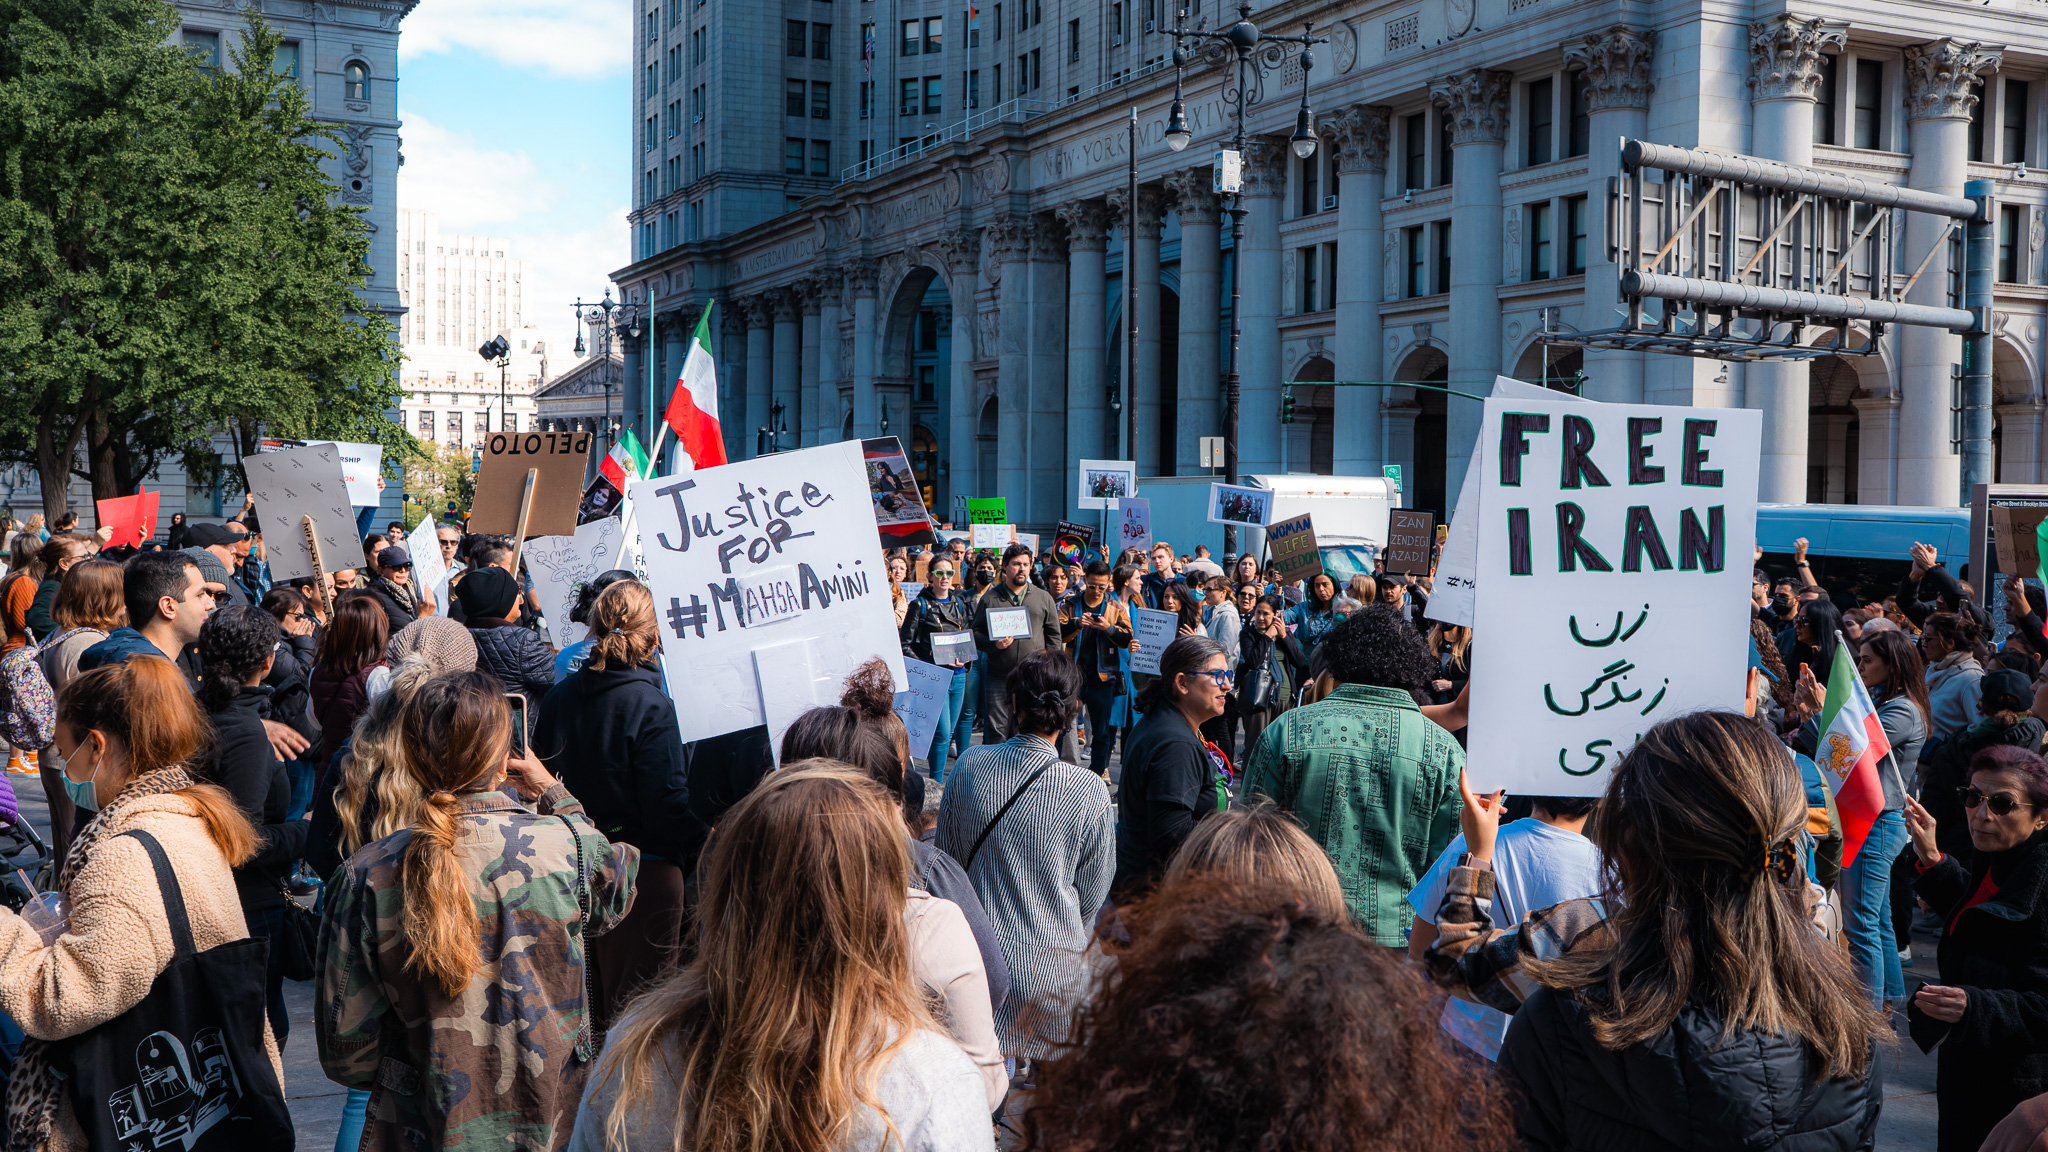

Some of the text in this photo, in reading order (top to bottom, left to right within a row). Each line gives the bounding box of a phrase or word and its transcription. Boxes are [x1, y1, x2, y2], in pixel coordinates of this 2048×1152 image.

[1043, 100, 1226, 177] NEW YORK MDXIV
[744, 246, 789, 276] AMSTERDAM
[483, 432, 589, 455] PELOTO
[1500, 412, 1724, 489] FREE
[655, 479, 833, 552] Justice
[969, 509, 1004, 517] WOMEN
[1397, 516, 1424, 529] ZAN
[1267, 517, 1311, 541] WOMAN
[1391, 534, 1429, 548] ZENDEGI
[1507, 502, 1725, 576] IRAN
[718, 518, 815, 574] FOR
[1276, 534, 1309, 556] LIFE
[1391, 550, 1424, 562] AZADI
[1274, 550, 1320, 574] FREEDOM
[1569, 603, 1649, 648] زن
[1544, 659, 1669, 716] زندگی
